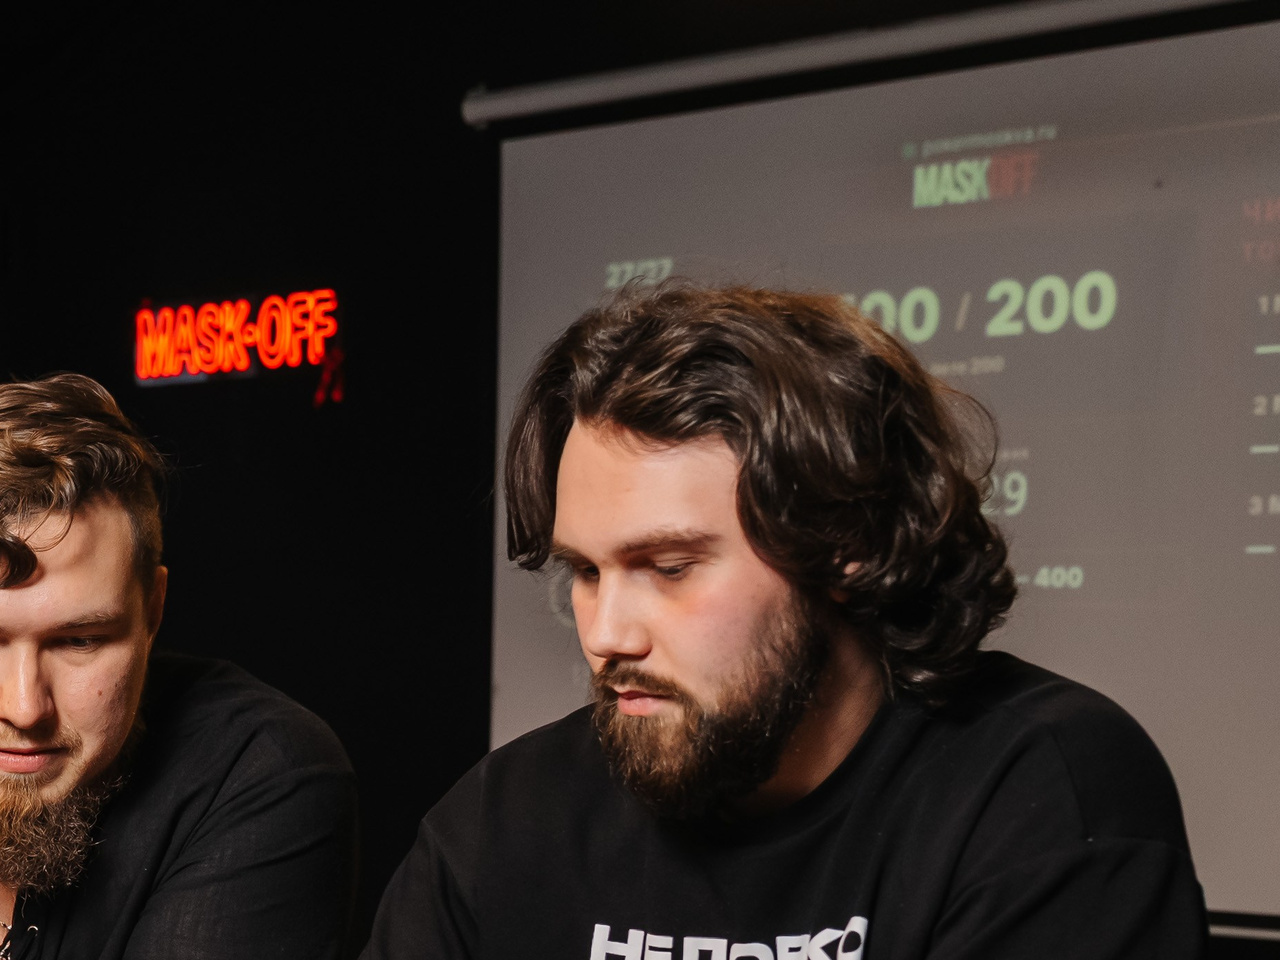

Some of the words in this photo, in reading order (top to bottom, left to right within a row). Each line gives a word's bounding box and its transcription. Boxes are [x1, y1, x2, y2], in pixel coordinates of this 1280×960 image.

[843, 285, 940, 344] 00
[985, 270, 1118, 338] 200
[1034, 565, 1084, 589] 400
